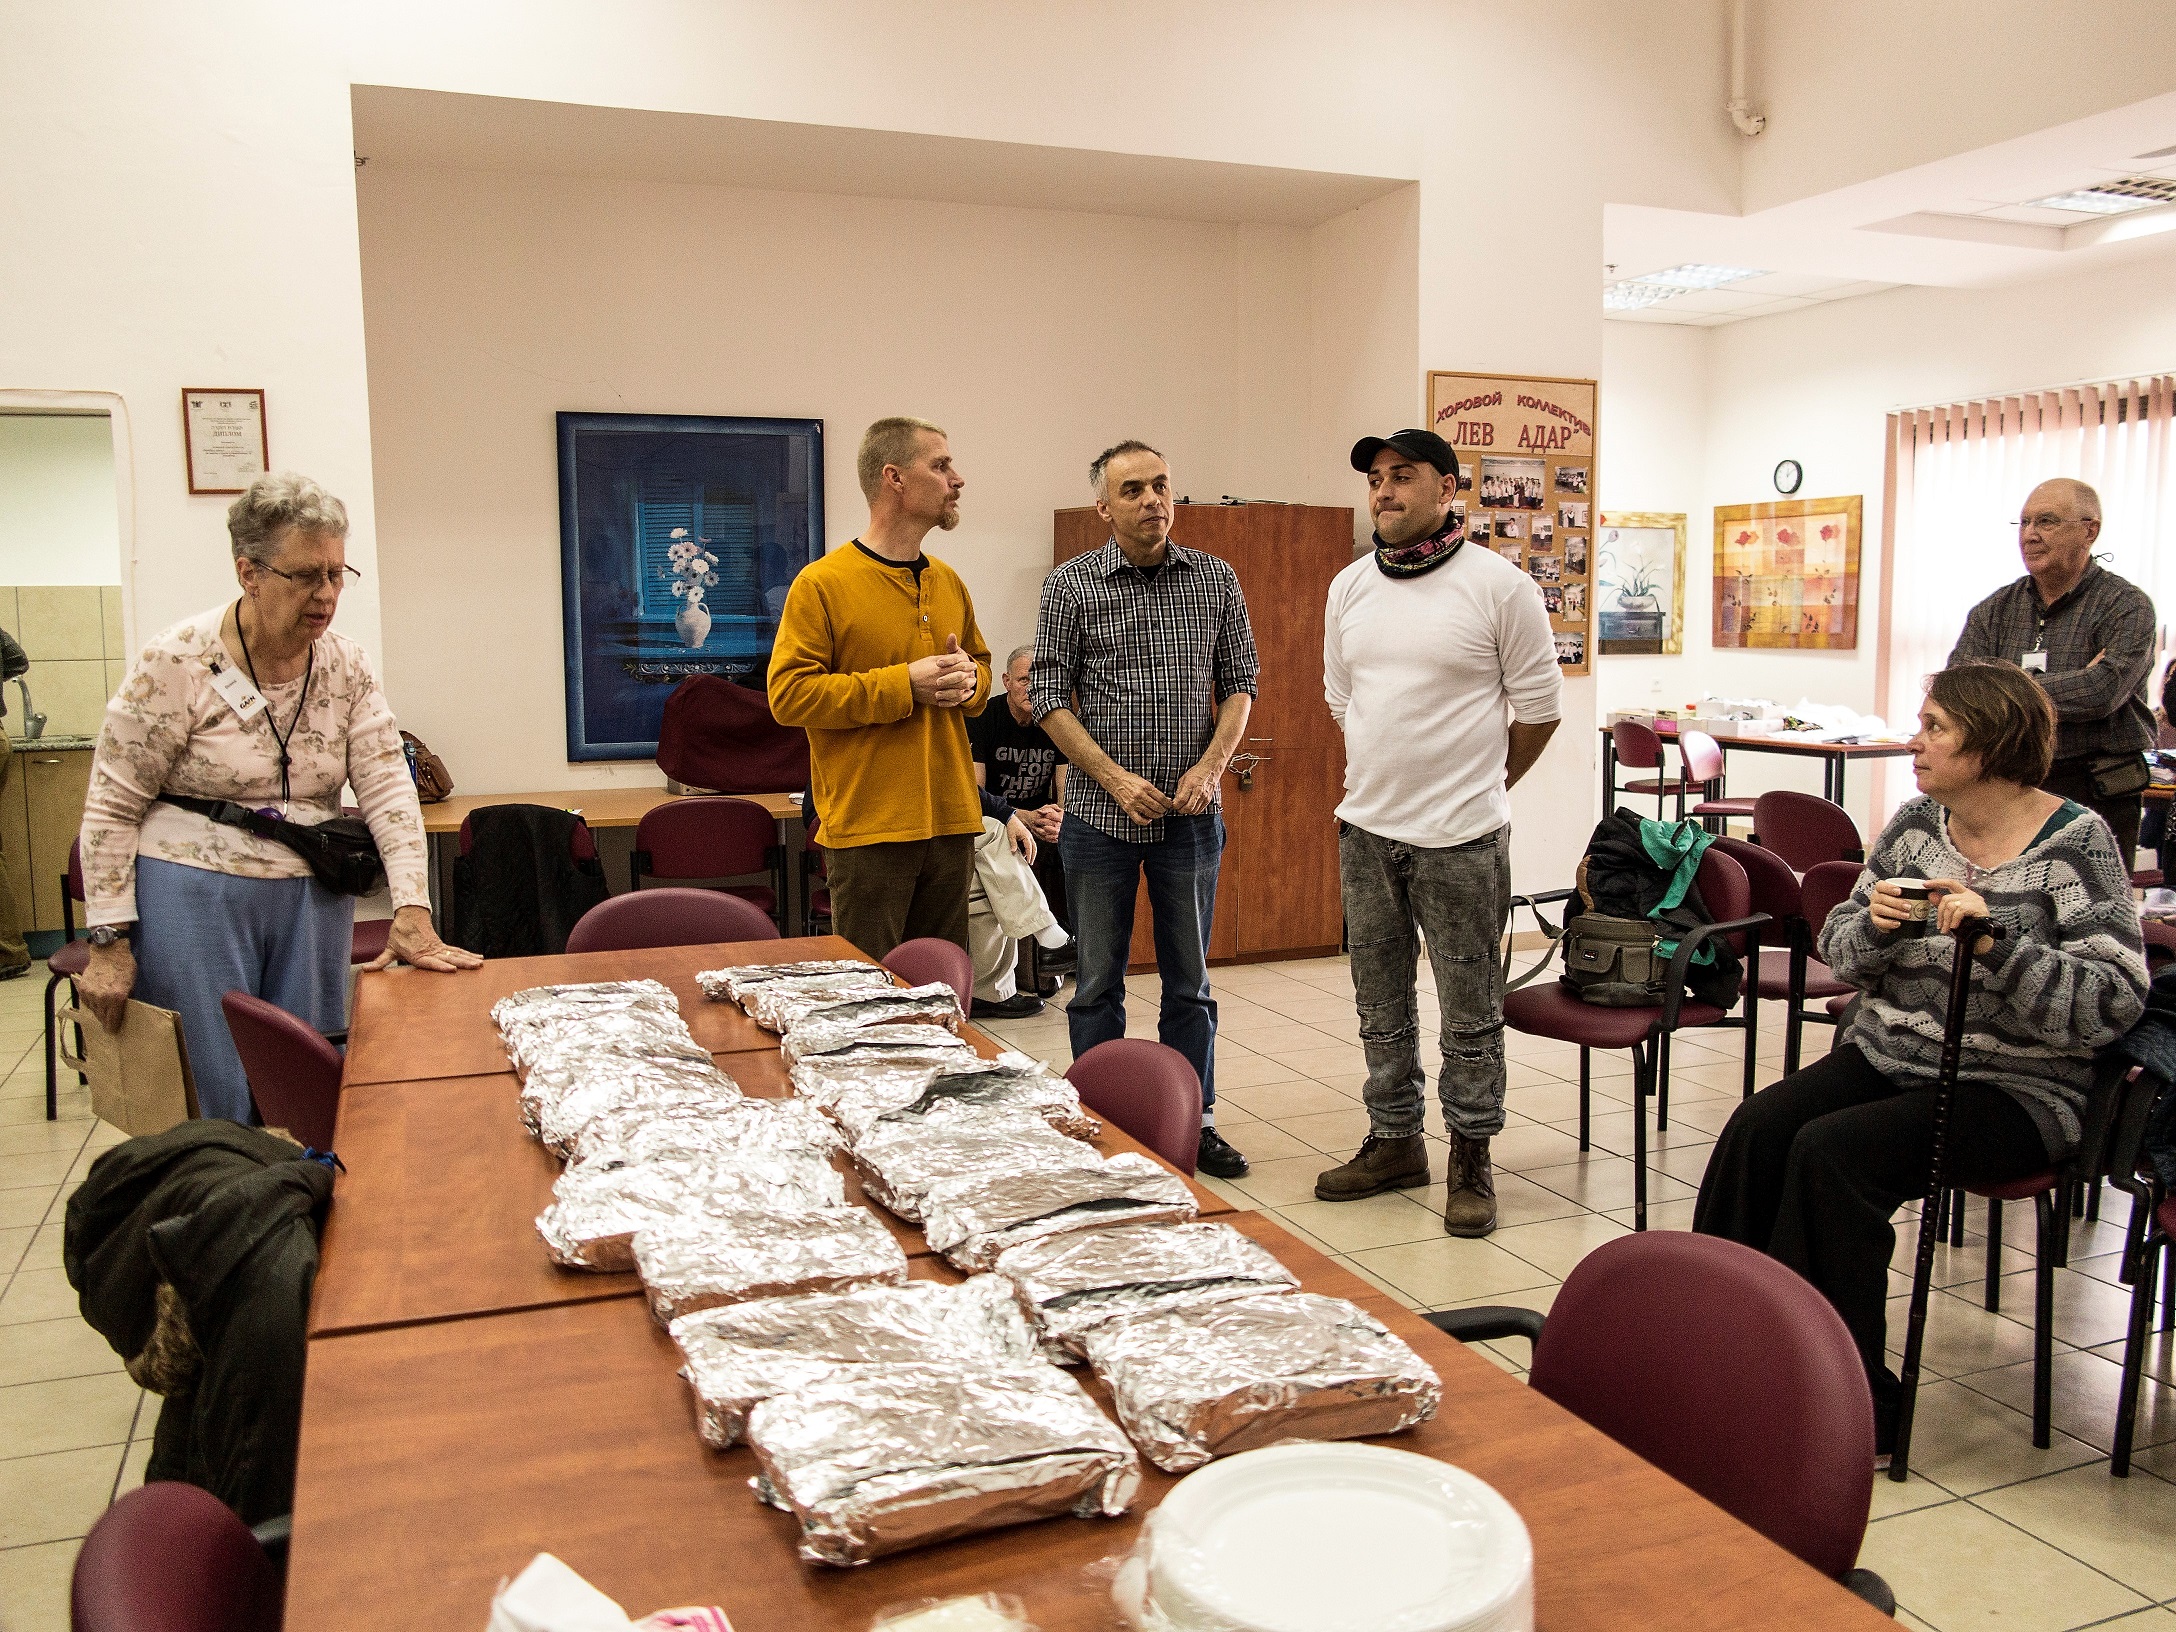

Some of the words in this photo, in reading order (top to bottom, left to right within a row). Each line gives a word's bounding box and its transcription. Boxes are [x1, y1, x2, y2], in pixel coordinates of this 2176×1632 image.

[1436, 391, 1502, 424] ХОРОВОЙ
[1517, 394, 1591, 436] КОЛЛЕКТИВ
[995, 746, 1055, 763] GIVING
[1018, 762, 1053, 777] FOR
